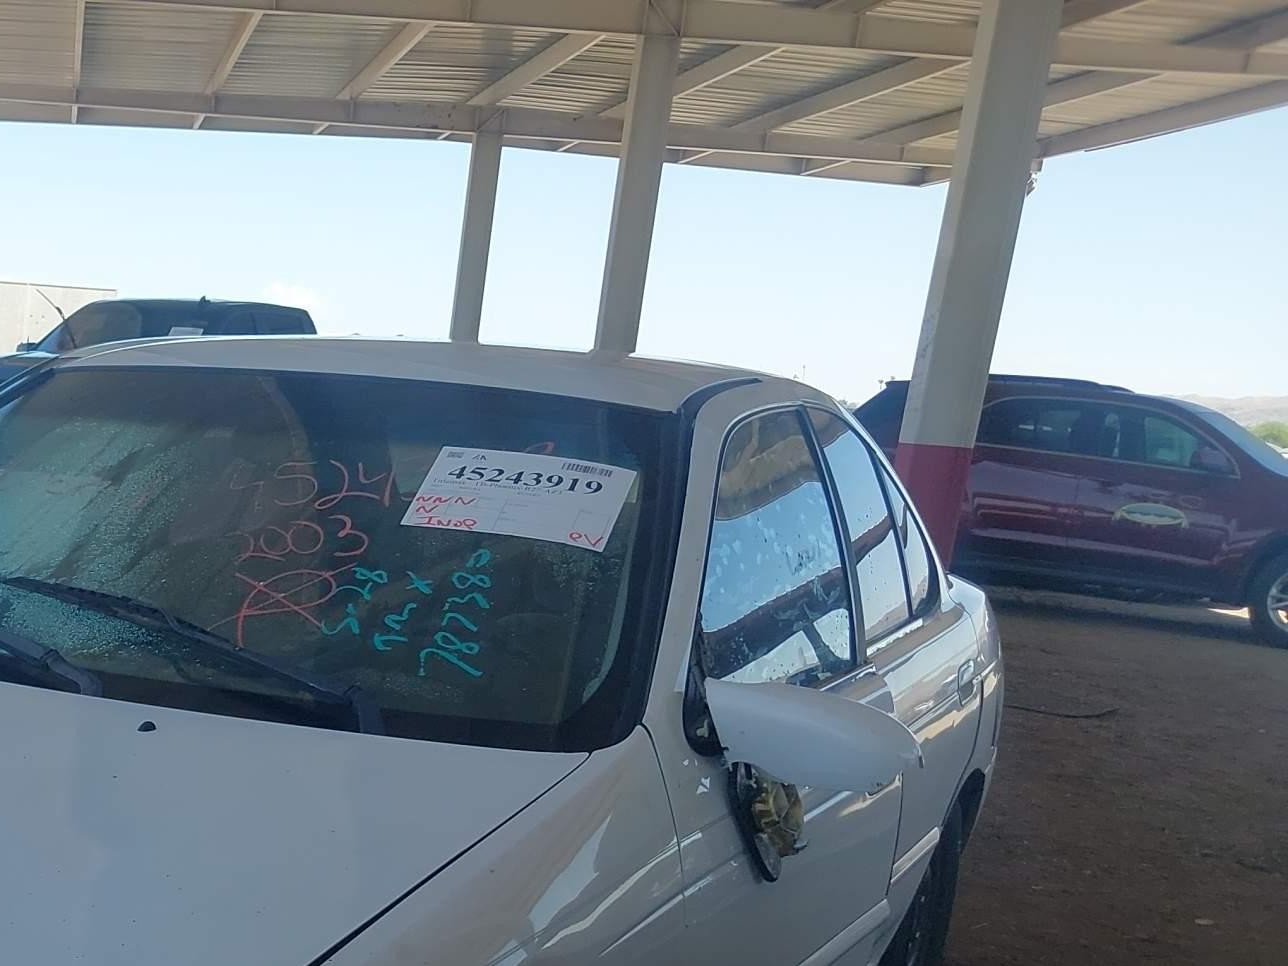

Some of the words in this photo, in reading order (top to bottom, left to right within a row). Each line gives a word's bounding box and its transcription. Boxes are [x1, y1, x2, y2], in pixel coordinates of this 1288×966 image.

[230, 459, 412, 510] 4524
[447, 465, 604, 495] 45243919
[225, 514, 369, 566] 2003
